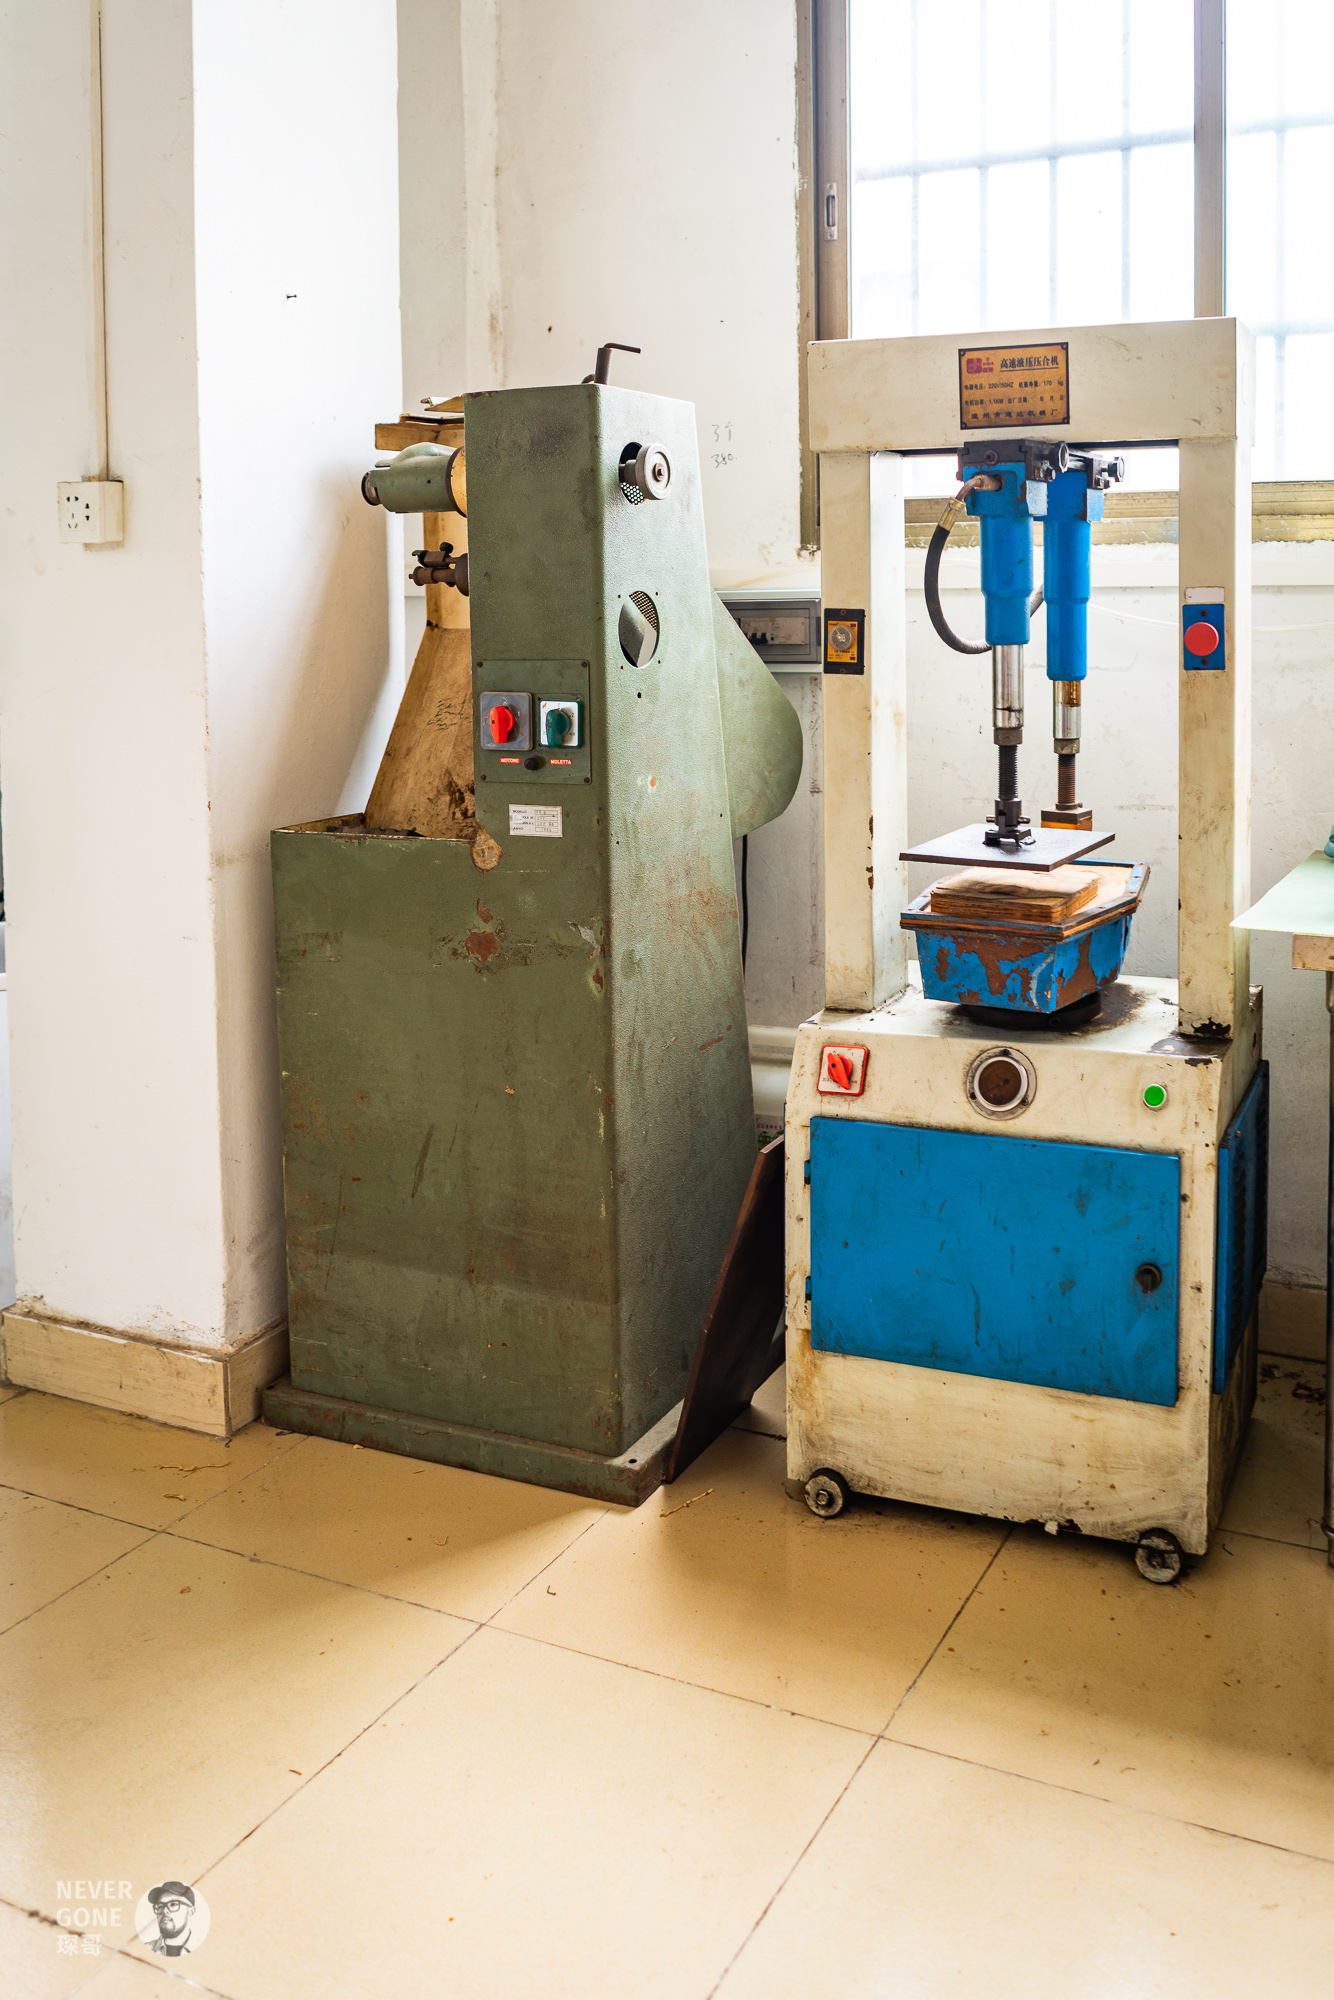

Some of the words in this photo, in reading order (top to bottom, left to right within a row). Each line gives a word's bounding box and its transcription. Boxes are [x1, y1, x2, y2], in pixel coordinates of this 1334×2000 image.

[1000, 355, 1059, 368] 高速液压压合机
